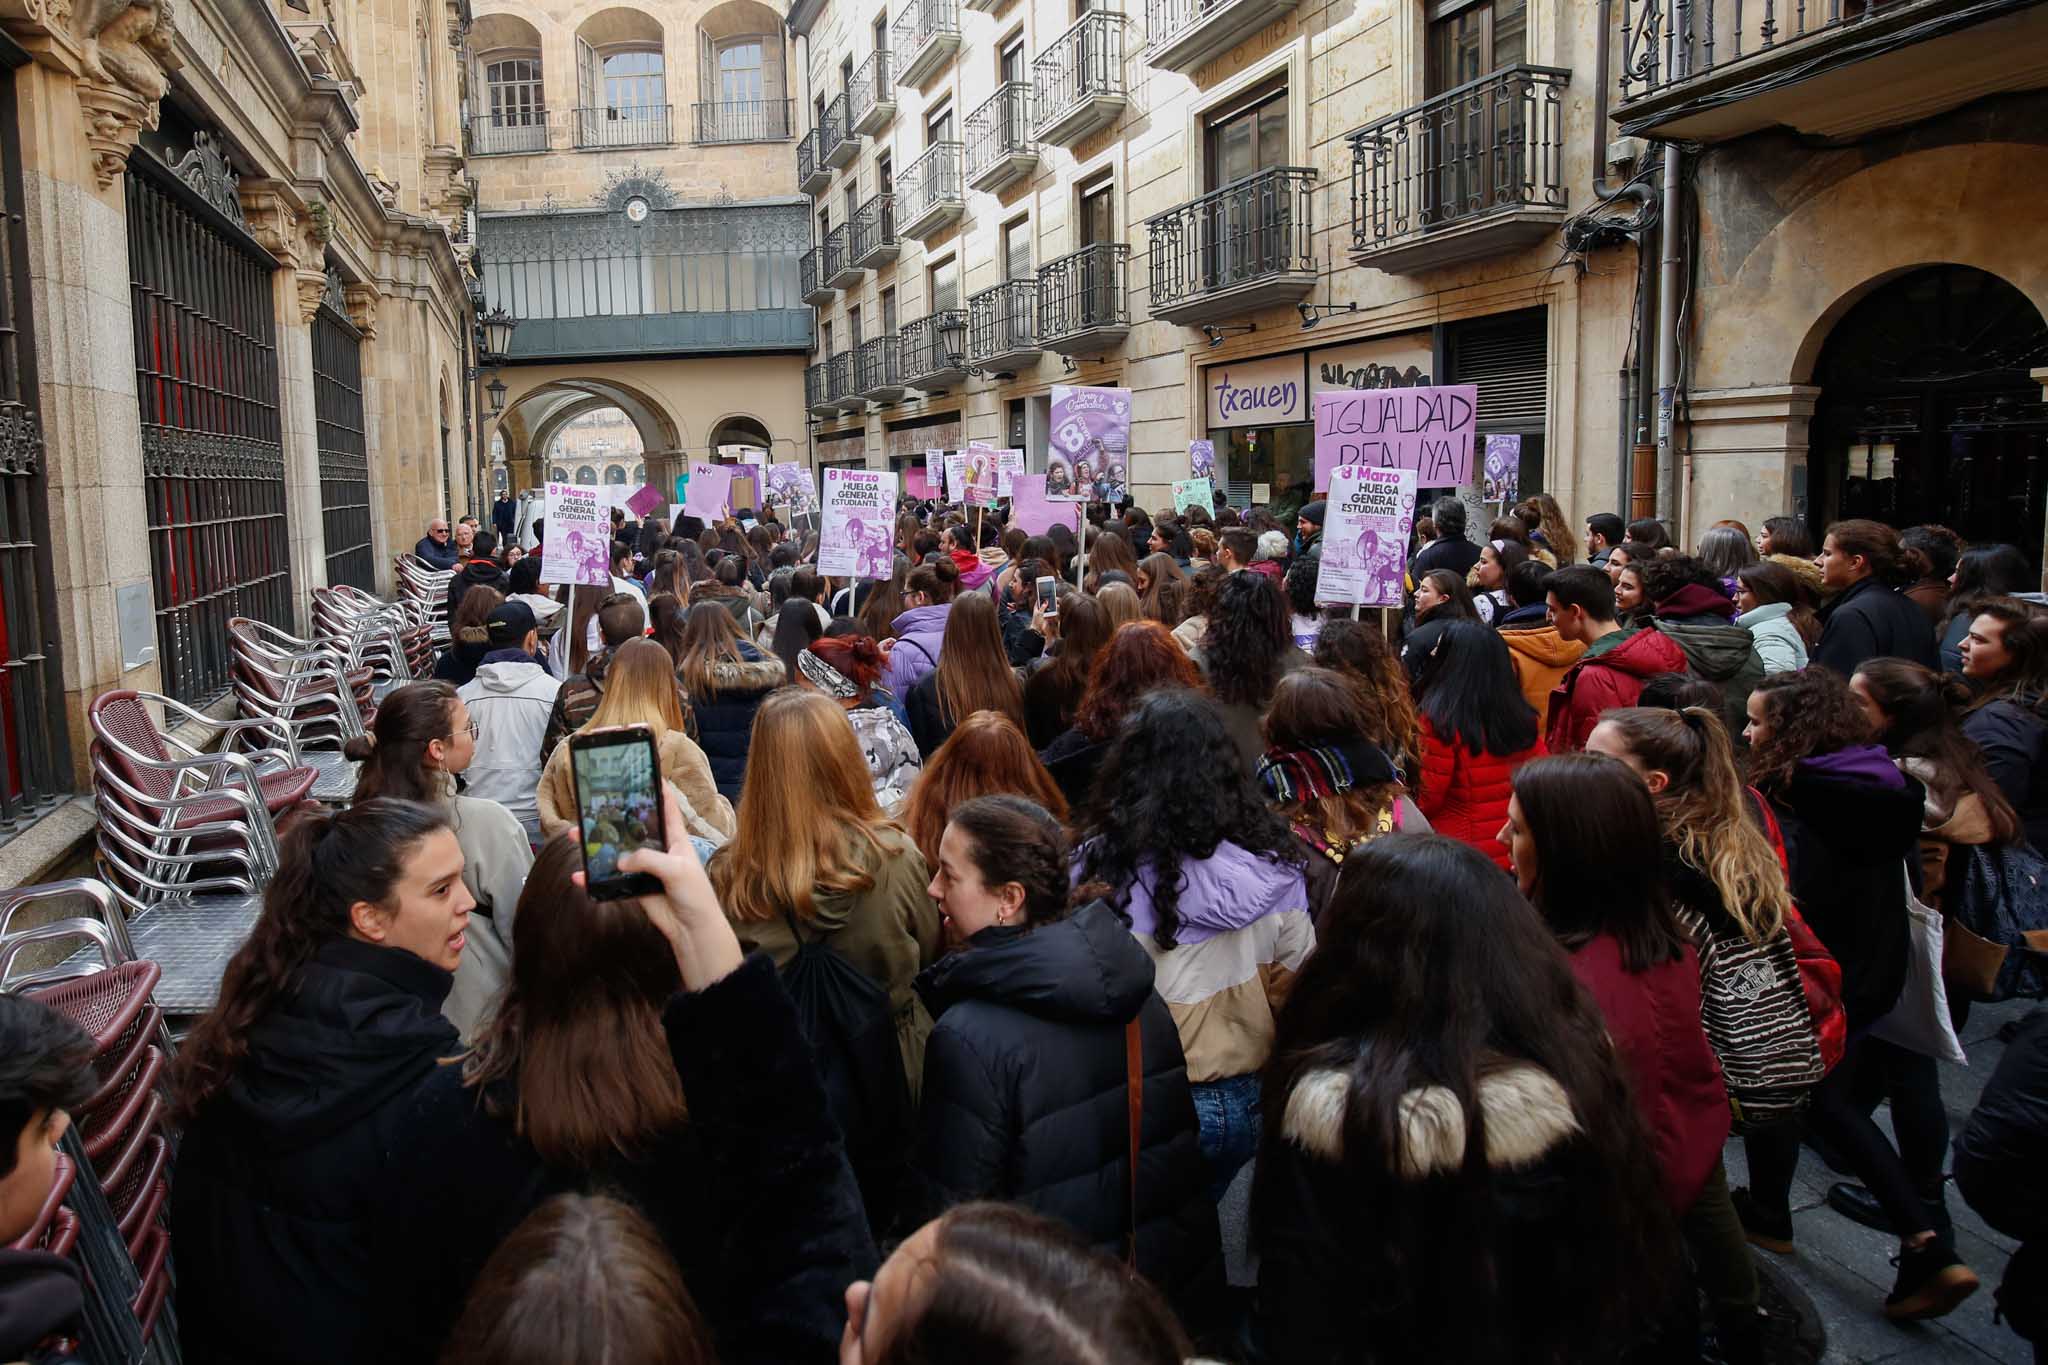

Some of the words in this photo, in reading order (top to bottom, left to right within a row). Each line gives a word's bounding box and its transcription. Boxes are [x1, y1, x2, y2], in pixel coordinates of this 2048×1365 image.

[1214, 372, 1297, 420] txauen
[1321, 393, 1472, 437] IGUALDAD
[1059, 423, 1084, 452] 8
[829, 470, 838, 480] 8
[841, 470, 879, 482] Marzo
[1341, 466, 1352, 480] 8
[1356, 467, 1400, 484] Marzo
[550, 485, 558, 495] 8
[561, 486, 596, 499] Marzo
[843, 482, 879, 492] HUELGA
[1358, 483, 1399, 495] HUELGA
[838, 490, 878, 500] GENERAL
[1350, 493, 1397, 506] GENERAL
[563, 497, 596, 507] HUELGA
[831, 499, 878, 507] ESTUDIANTIL
[559, 504, 596, 515] GENERAL
[1341, 503, 1396, 516] ESTUDIANTIL
[553, 512, 596, 521] ESTUDIANTIL
